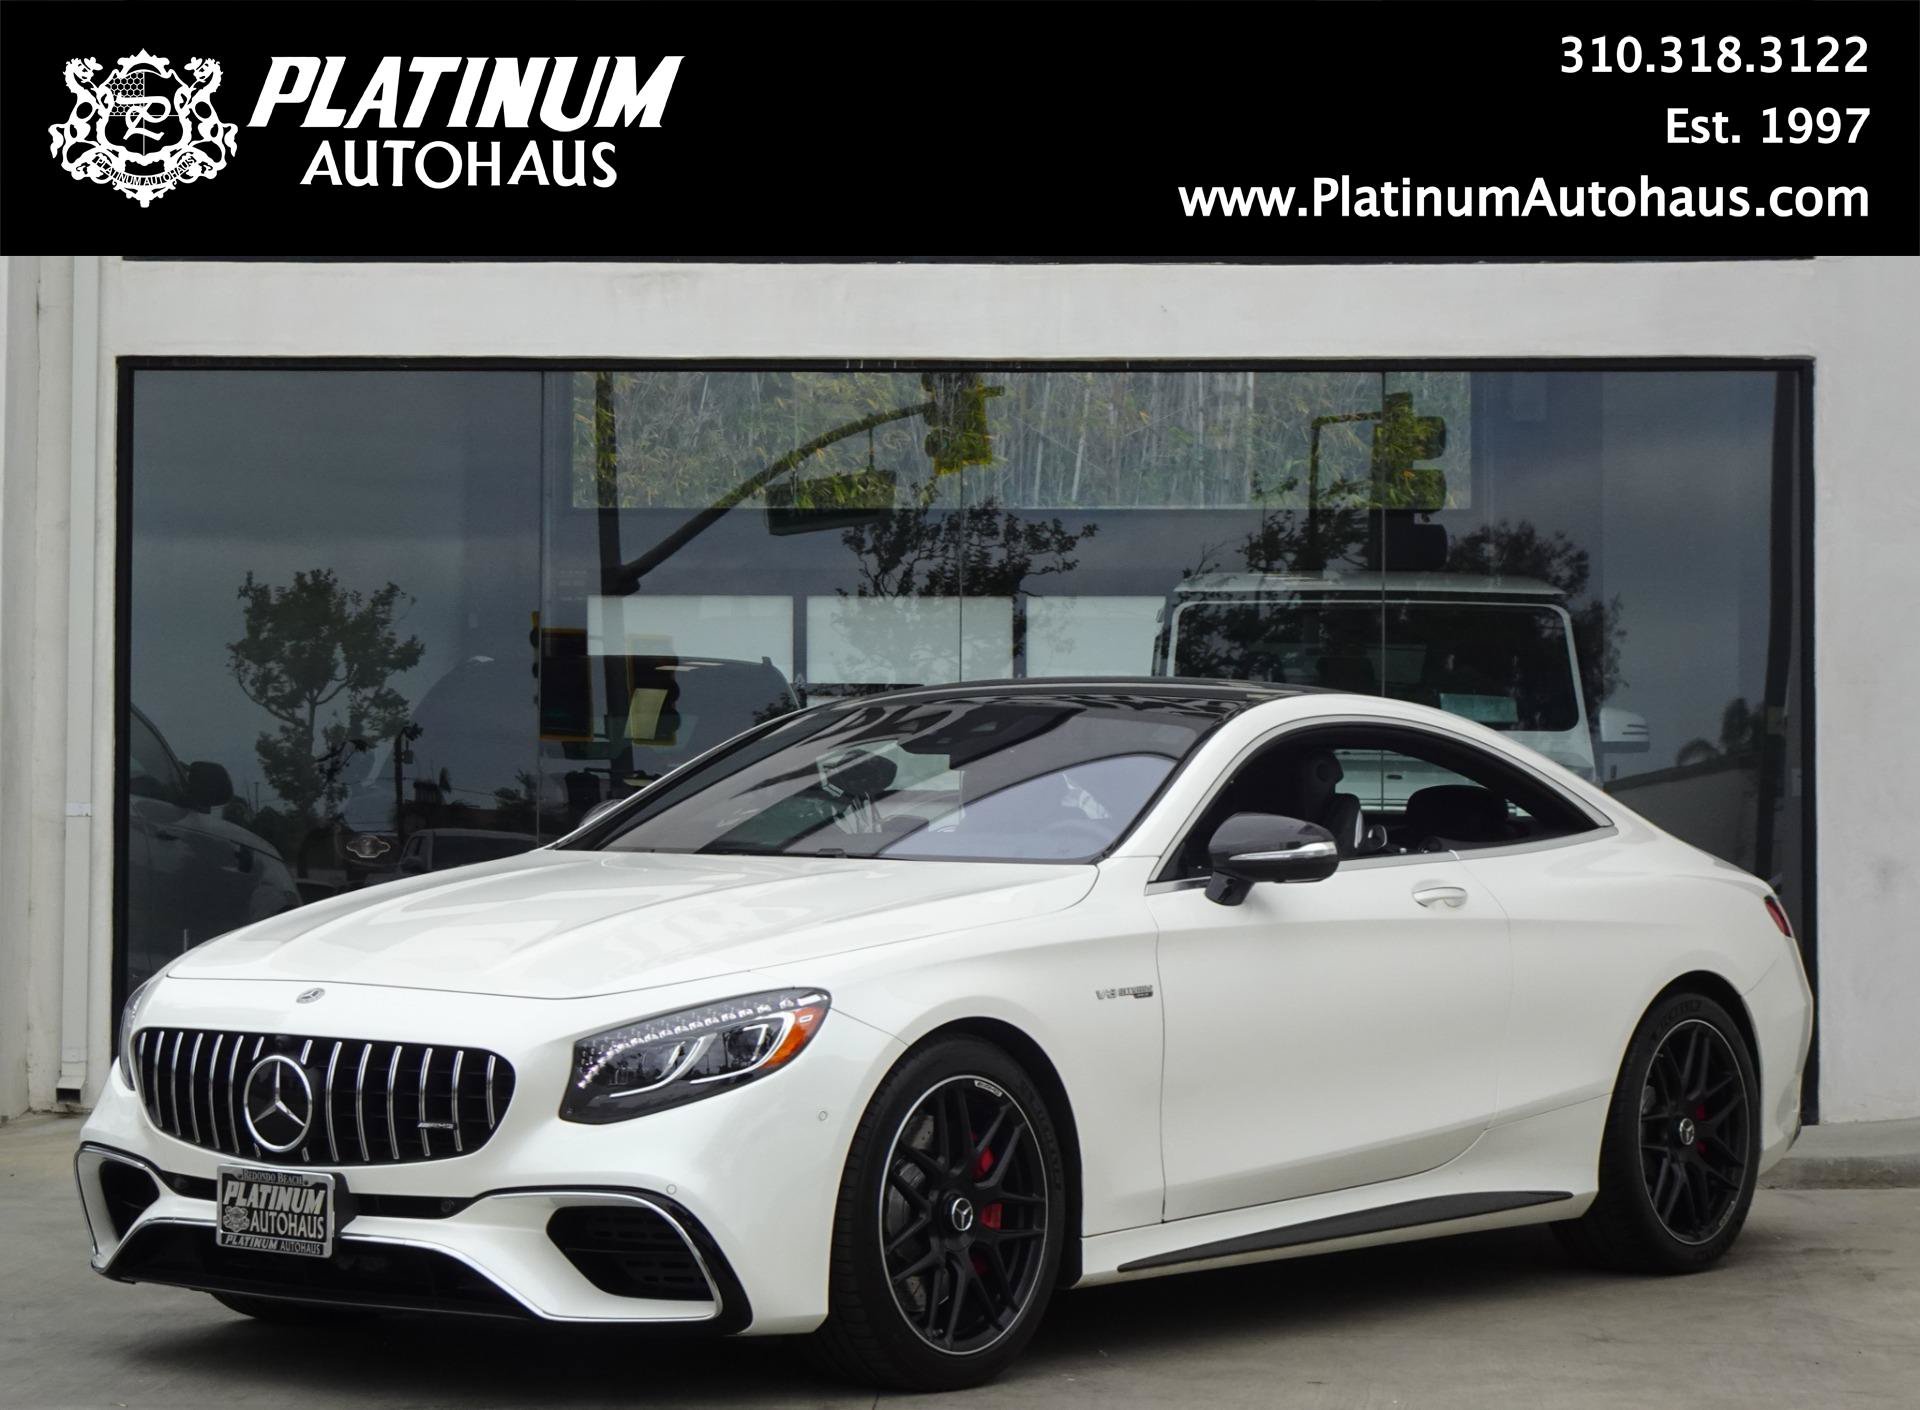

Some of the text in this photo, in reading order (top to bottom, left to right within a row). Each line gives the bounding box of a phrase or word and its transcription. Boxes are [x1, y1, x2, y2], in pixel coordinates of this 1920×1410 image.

[222, 1180, 326, 1215] PLATINUM
[249, 1210, 324, 1239] AUTOHAUS
[225, 1234, 321, 1255] PLATINUM AUTOHAUS
